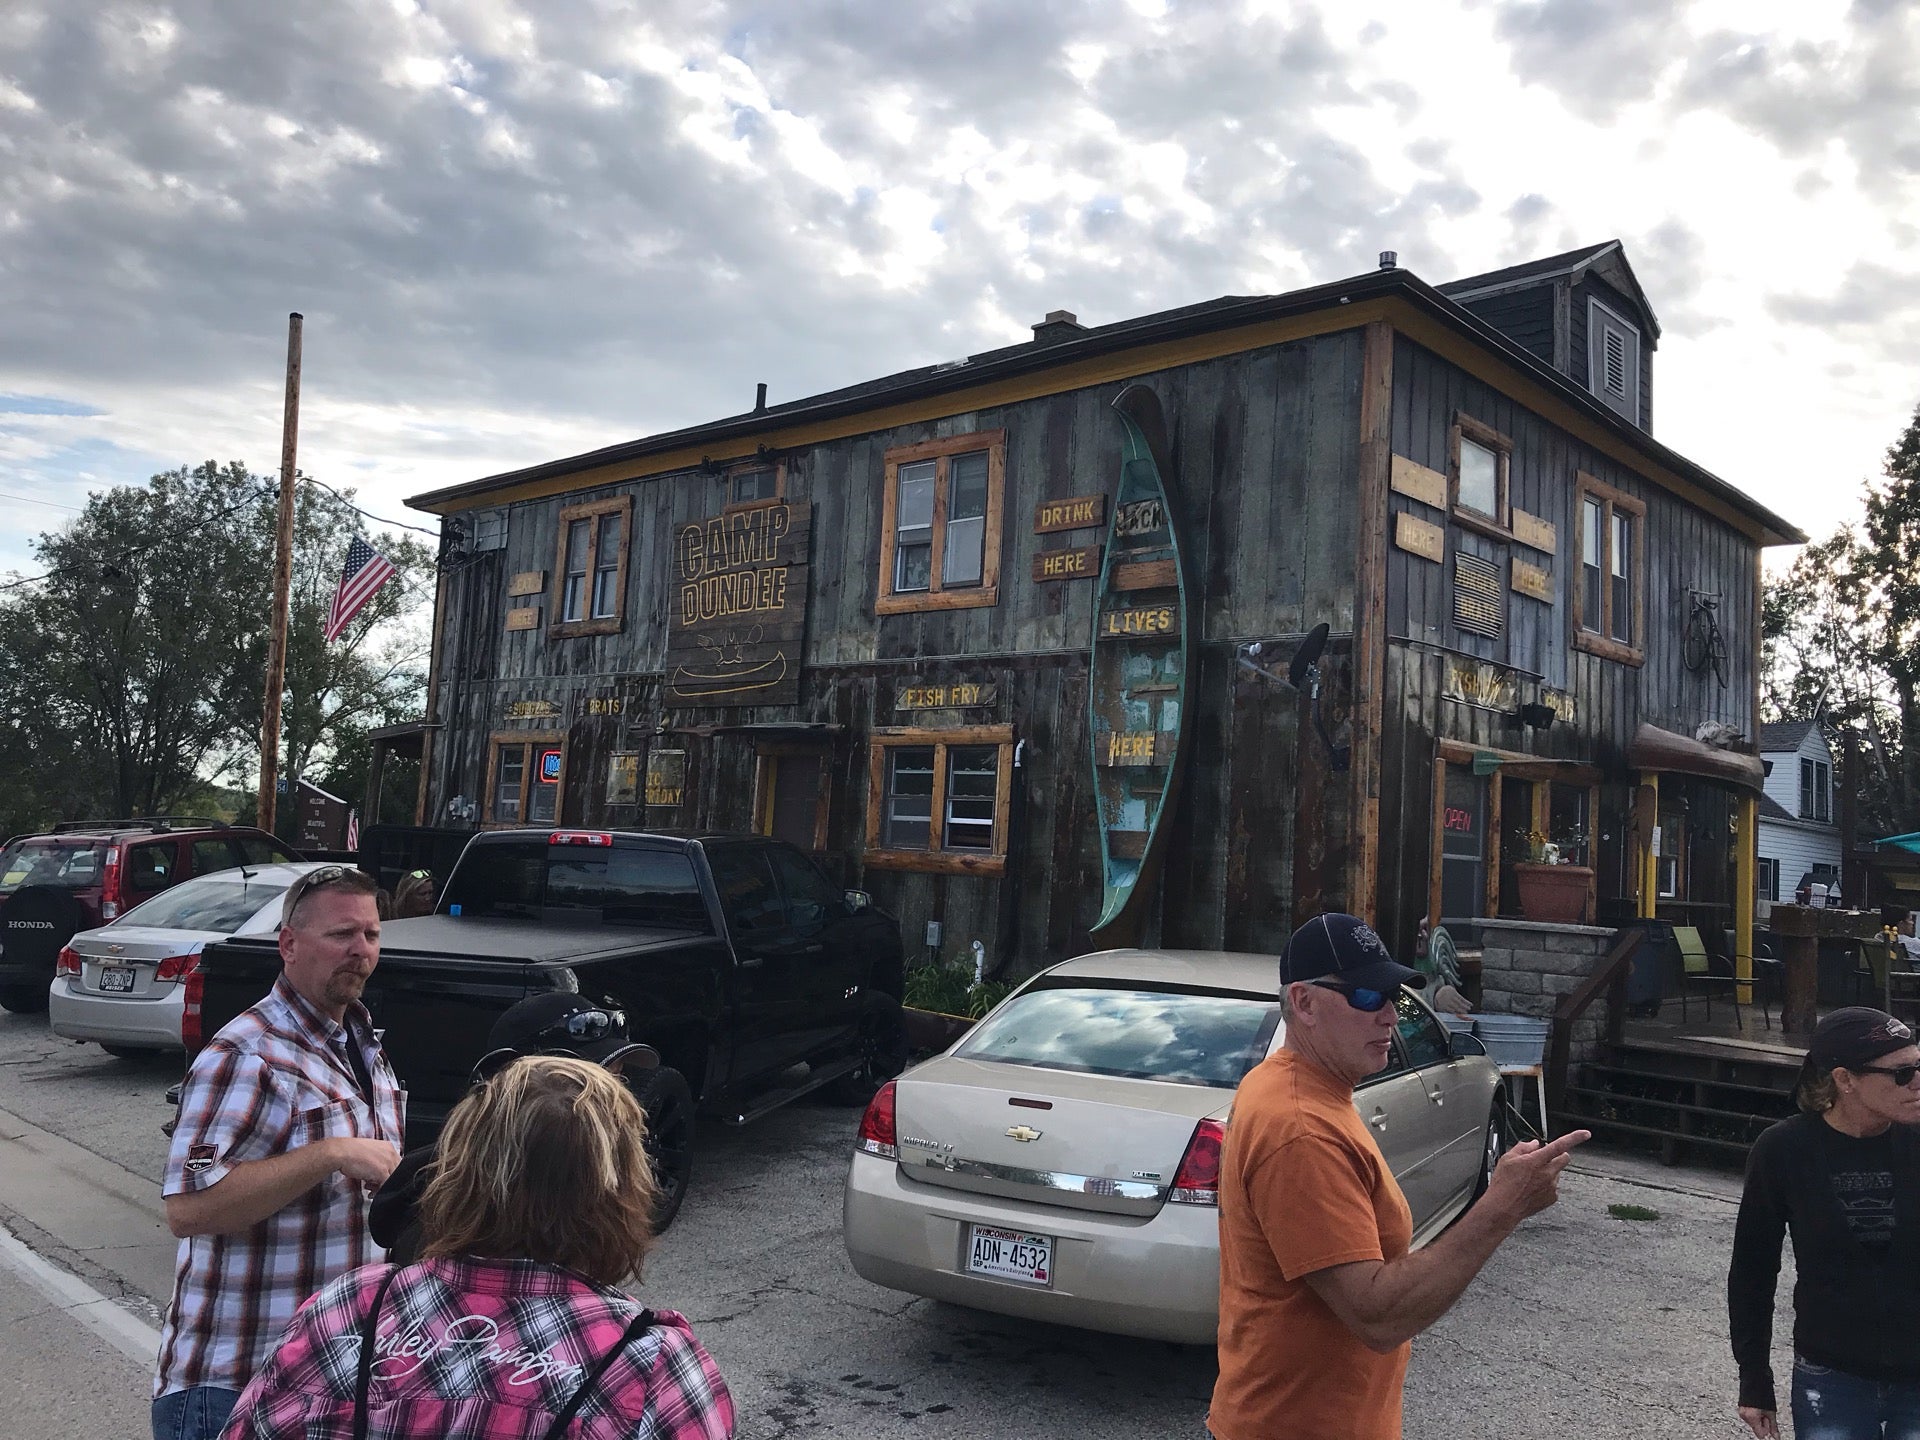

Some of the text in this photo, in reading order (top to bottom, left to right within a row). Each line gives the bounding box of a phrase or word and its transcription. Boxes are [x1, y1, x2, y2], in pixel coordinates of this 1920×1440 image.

[1042, 502, 1093, 527] DRINK
[681, 505, 790, 580] CAMP
[1404, 522, 1433, 553] HERE
[1044, 553, 1085, 575] HERE
[1521, 568, 1546, 594] HERE
[682, 568, 787, 625] DUNDEE
[1110, 610, 1169, 633] LIVES
[907, 686, 980, 706] FISH FRY
[589, 699, 620, 716] BRATS
[1109, 737, 1154, 758] HERE
[646, 789, 682, 804] RIDAY
[1444, 807, 1471, 832] OPEN
[7, 920, 55, 929] HONDA
[903, 1135, 939, 1149] IMPALA
[975, 1227, 1017, 1241] WISCONSIN
[974, 1238, 1047, 1272] ADN-4532
